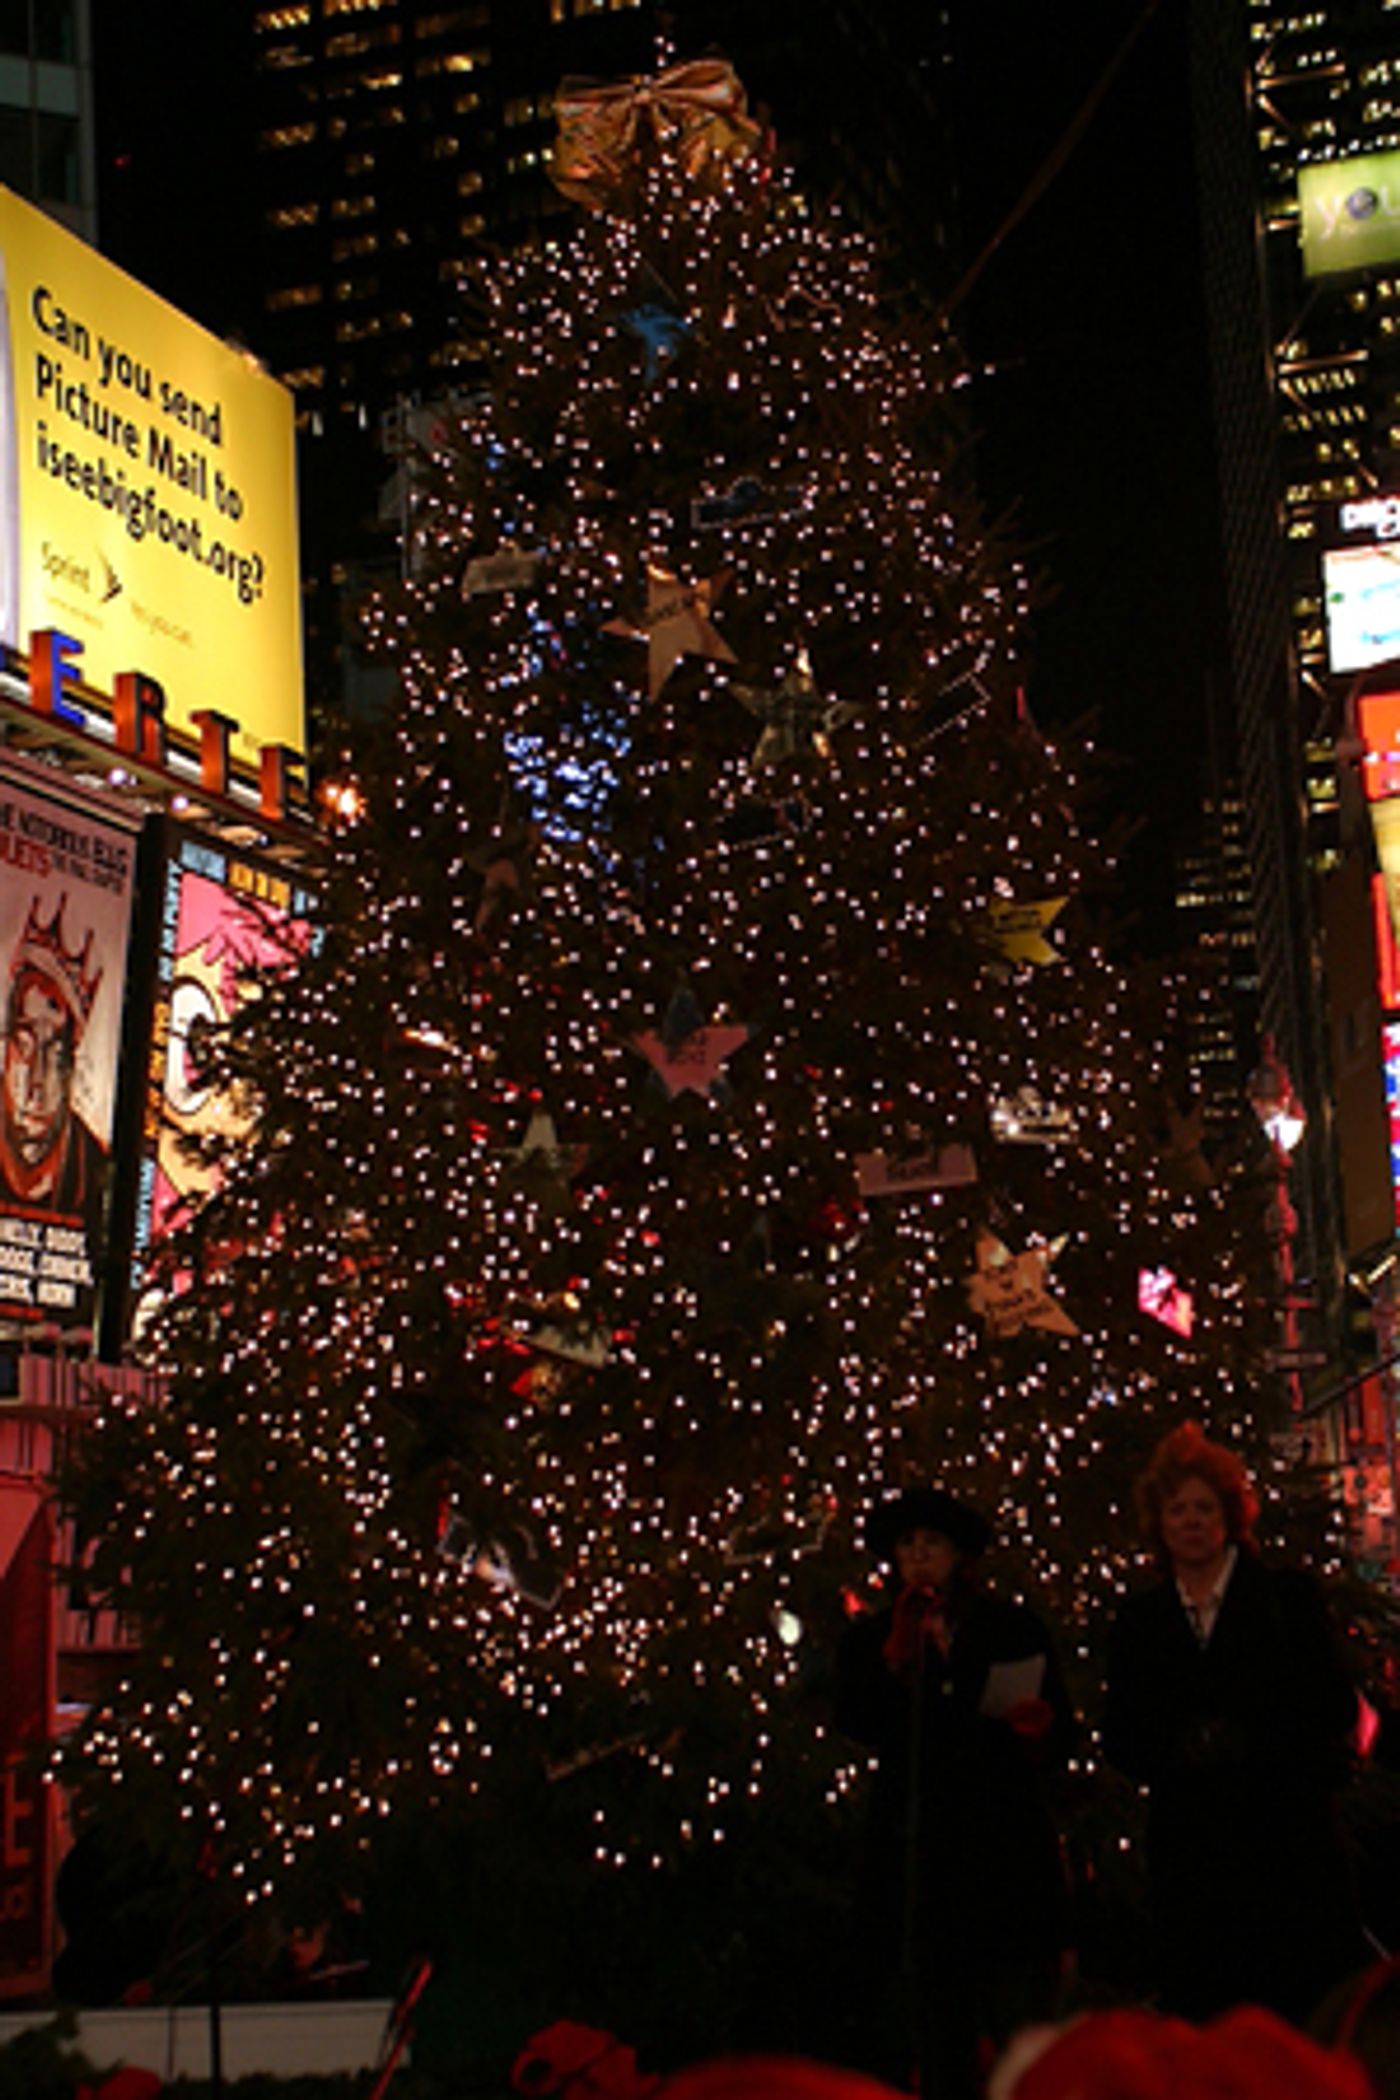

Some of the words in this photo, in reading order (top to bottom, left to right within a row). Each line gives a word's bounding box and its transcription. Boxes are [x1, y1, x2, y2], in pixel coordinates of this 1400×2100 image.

[32, 286, 91, 360] Can
[98, 338, 152, 400] you
[160, 380, 223, 446] send
[36, 355, 138, 458] Picture
[148, 428, 207, 498] Mail
[214, 468, 244, 519] to
[37, 422, 265, 605] iseebigfoot.org?
